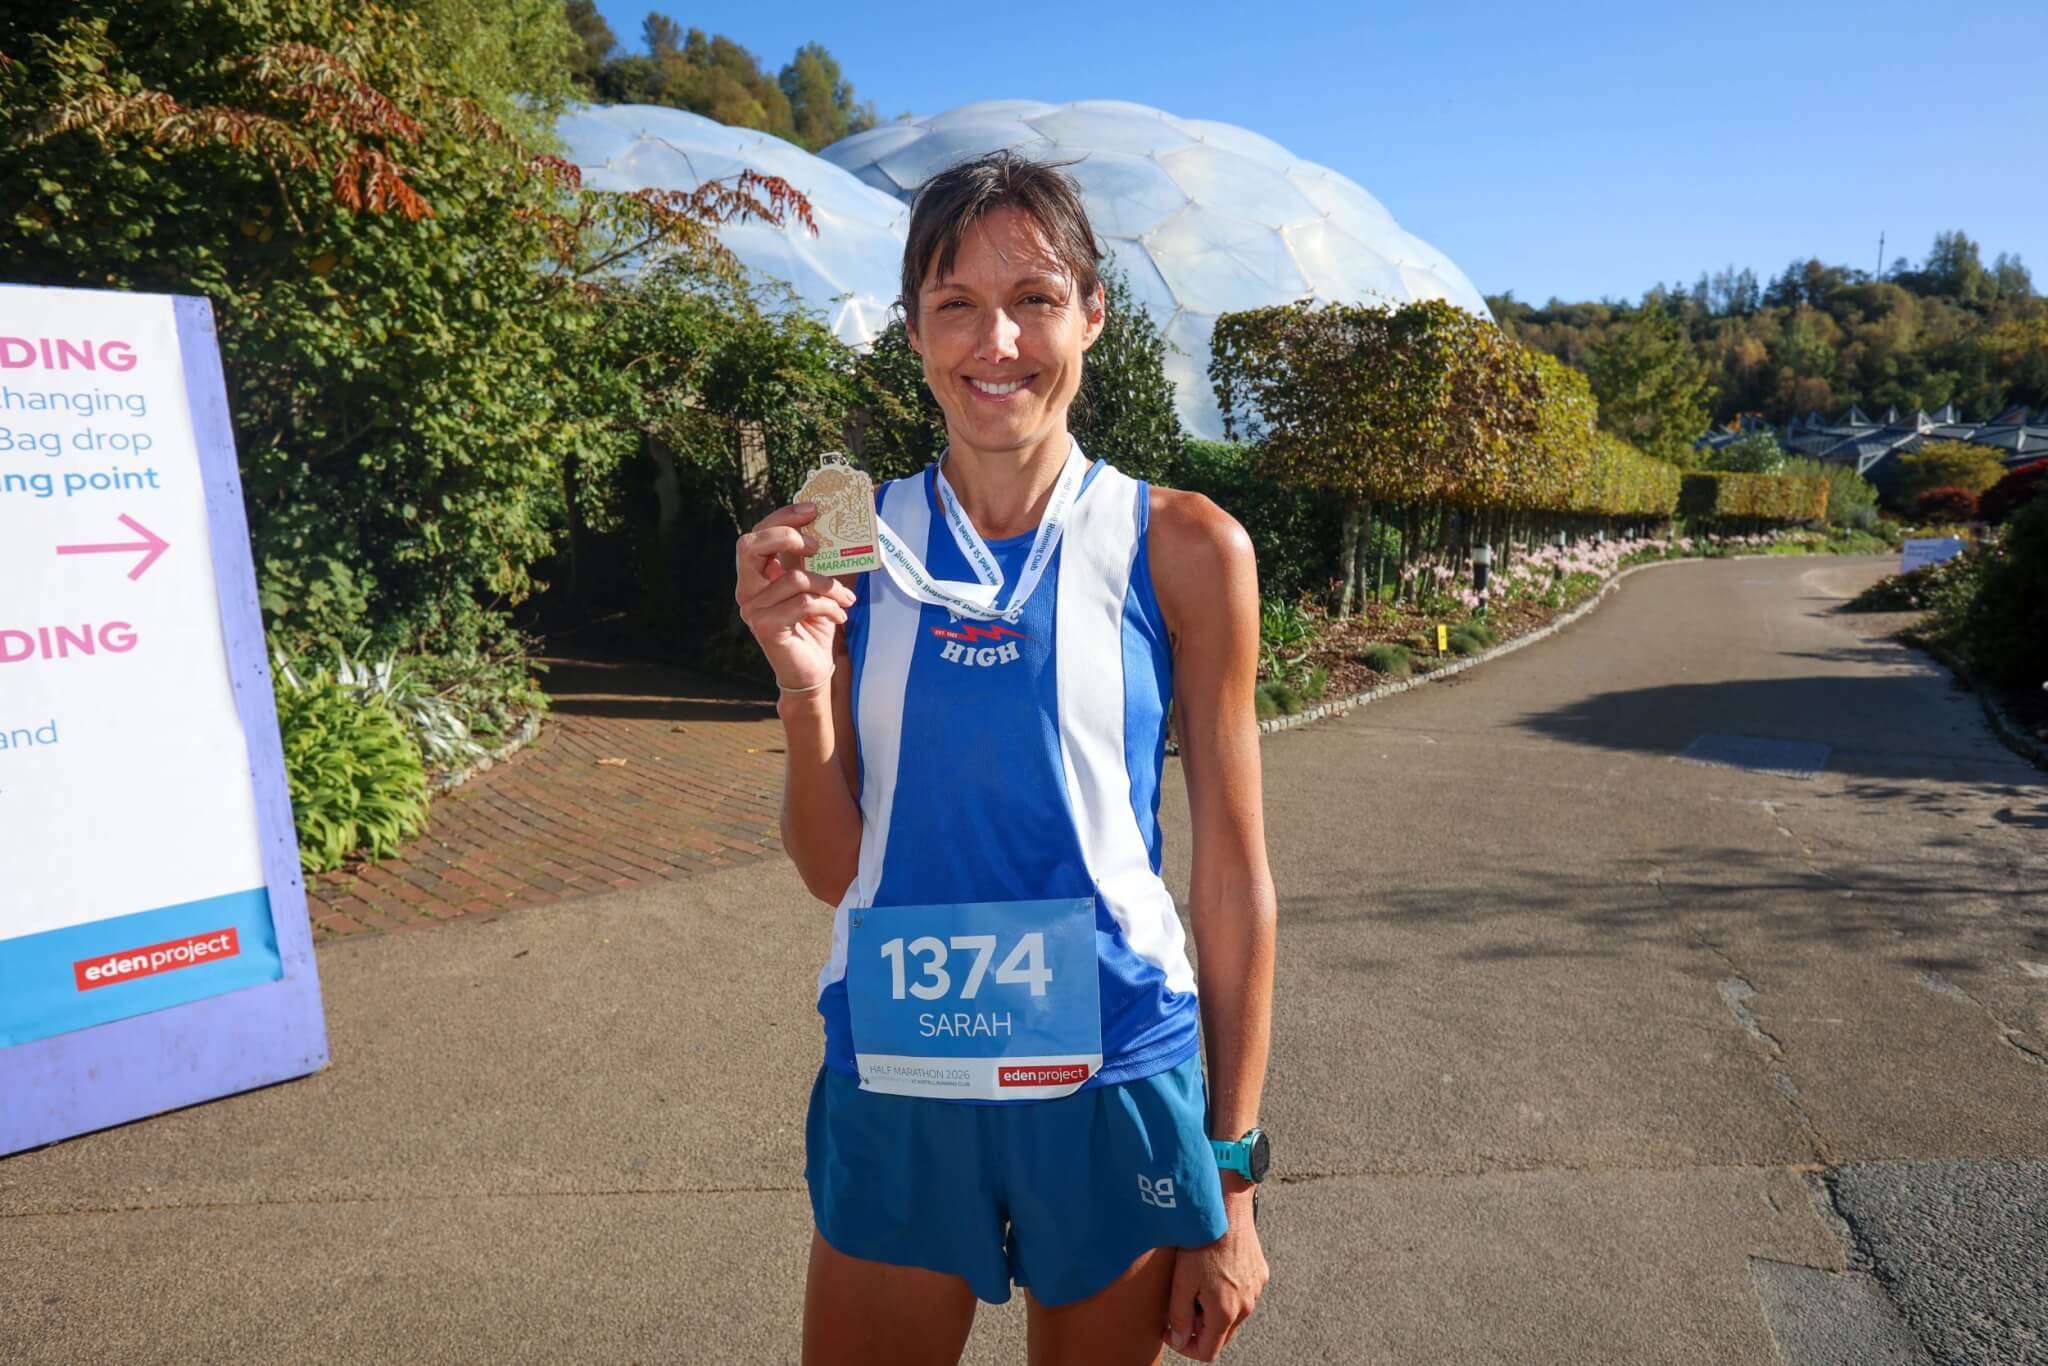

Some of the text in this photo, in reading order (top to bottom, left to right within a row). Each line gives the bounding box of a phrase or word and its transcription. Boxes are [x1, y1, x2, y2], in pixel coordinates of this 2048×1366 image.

[0, 337, 138, 372] DING
[0, 385, 147, 417] hanging
[72, 427, 153, 456] drop
[0, 466, 160, 498] ng point
[816, 551, 838, 561] 2026
[879, 533, 896, 553] Club
[816, 556, 874, 572] MARATHON
[894, 551, 922, 586] Running
[0, 621, 138, 663] DING
[940, 640, 1020, 667] HIGH
[84, 934, 231, 981] eden project
[881, 932, 1053, 1001] 1374
[919, 1012, 1012, 1037] SARAH
[870, 1065, 892, 1074] HALF
[893, 1067, 943, 1079] MARATHON
[946, 1070, 970, 1079] 2026
[1003, 1068, 1084, 1083] eden project
